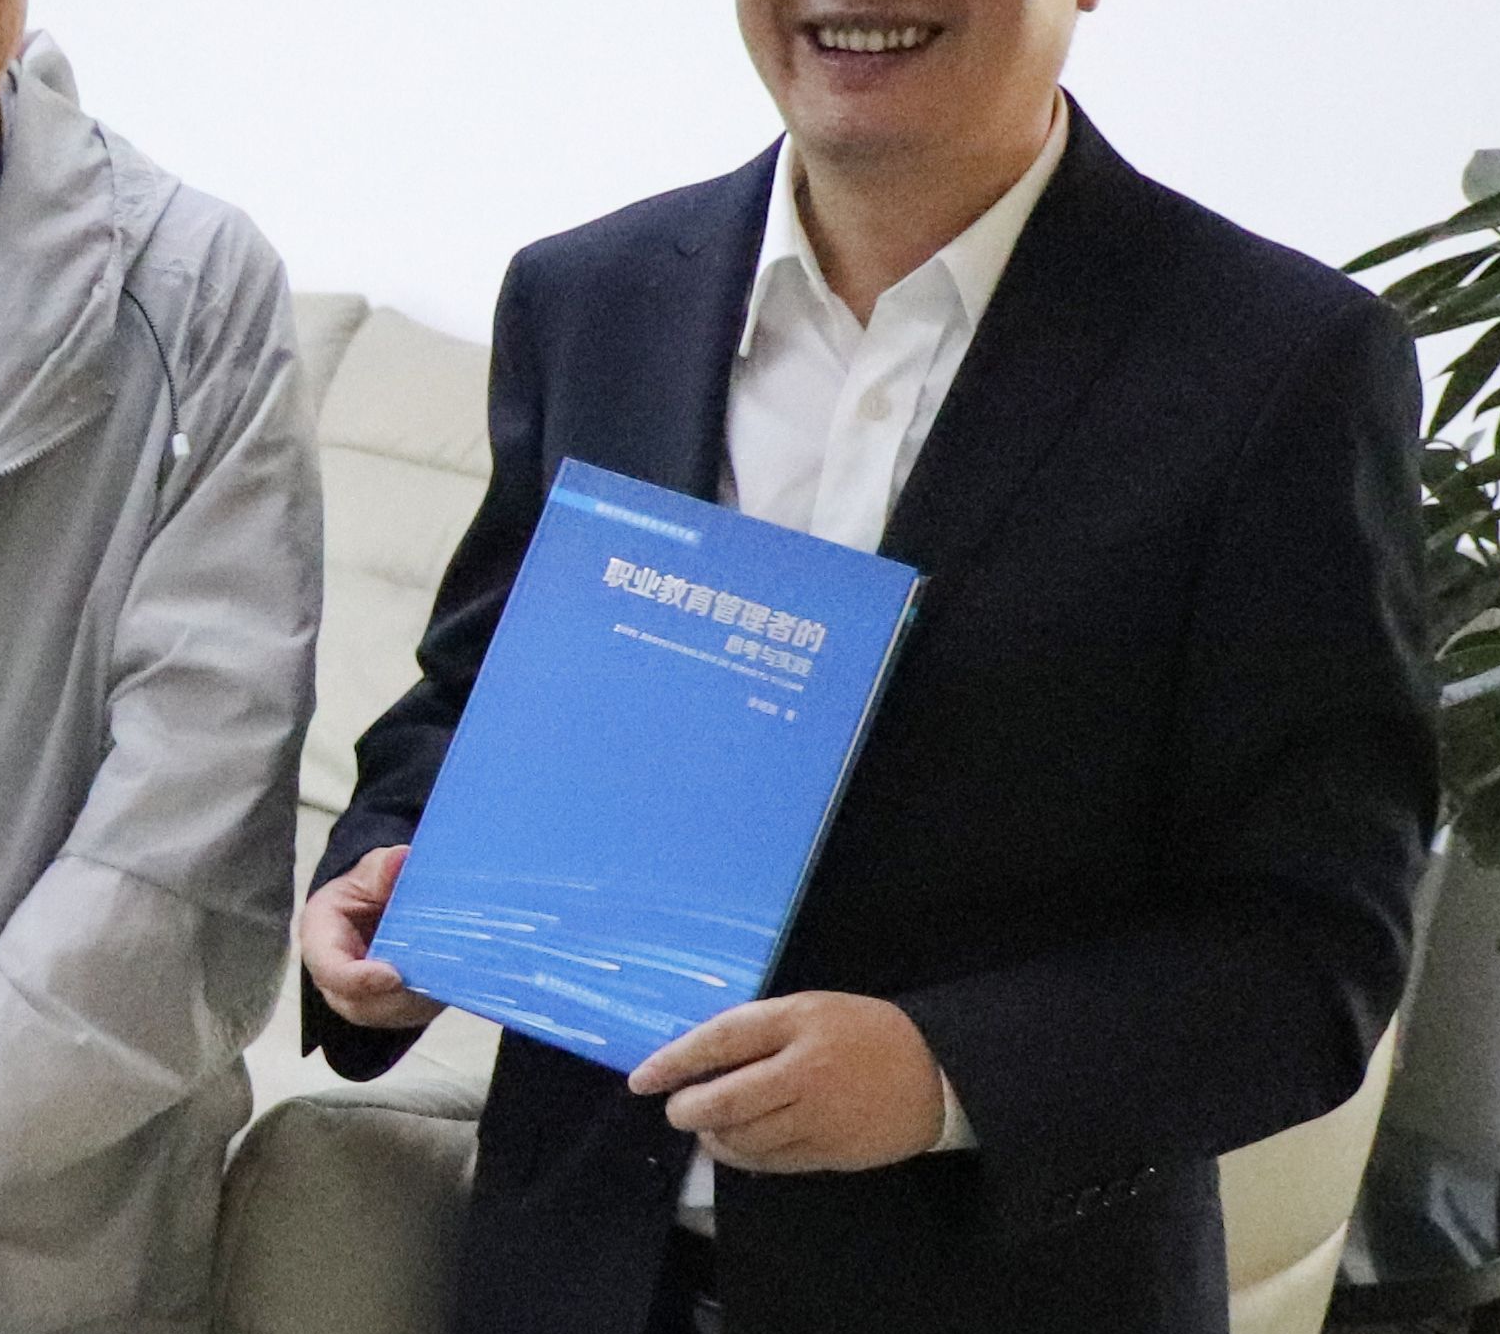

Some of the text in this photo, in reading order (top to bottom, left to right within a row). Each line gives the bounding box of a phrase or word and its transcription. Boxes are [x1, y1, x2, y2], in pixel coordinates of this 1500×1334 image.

[602, 557, 826, 652] 职业教育管理者的
[725, 634, 812, 677] 思考与实践
